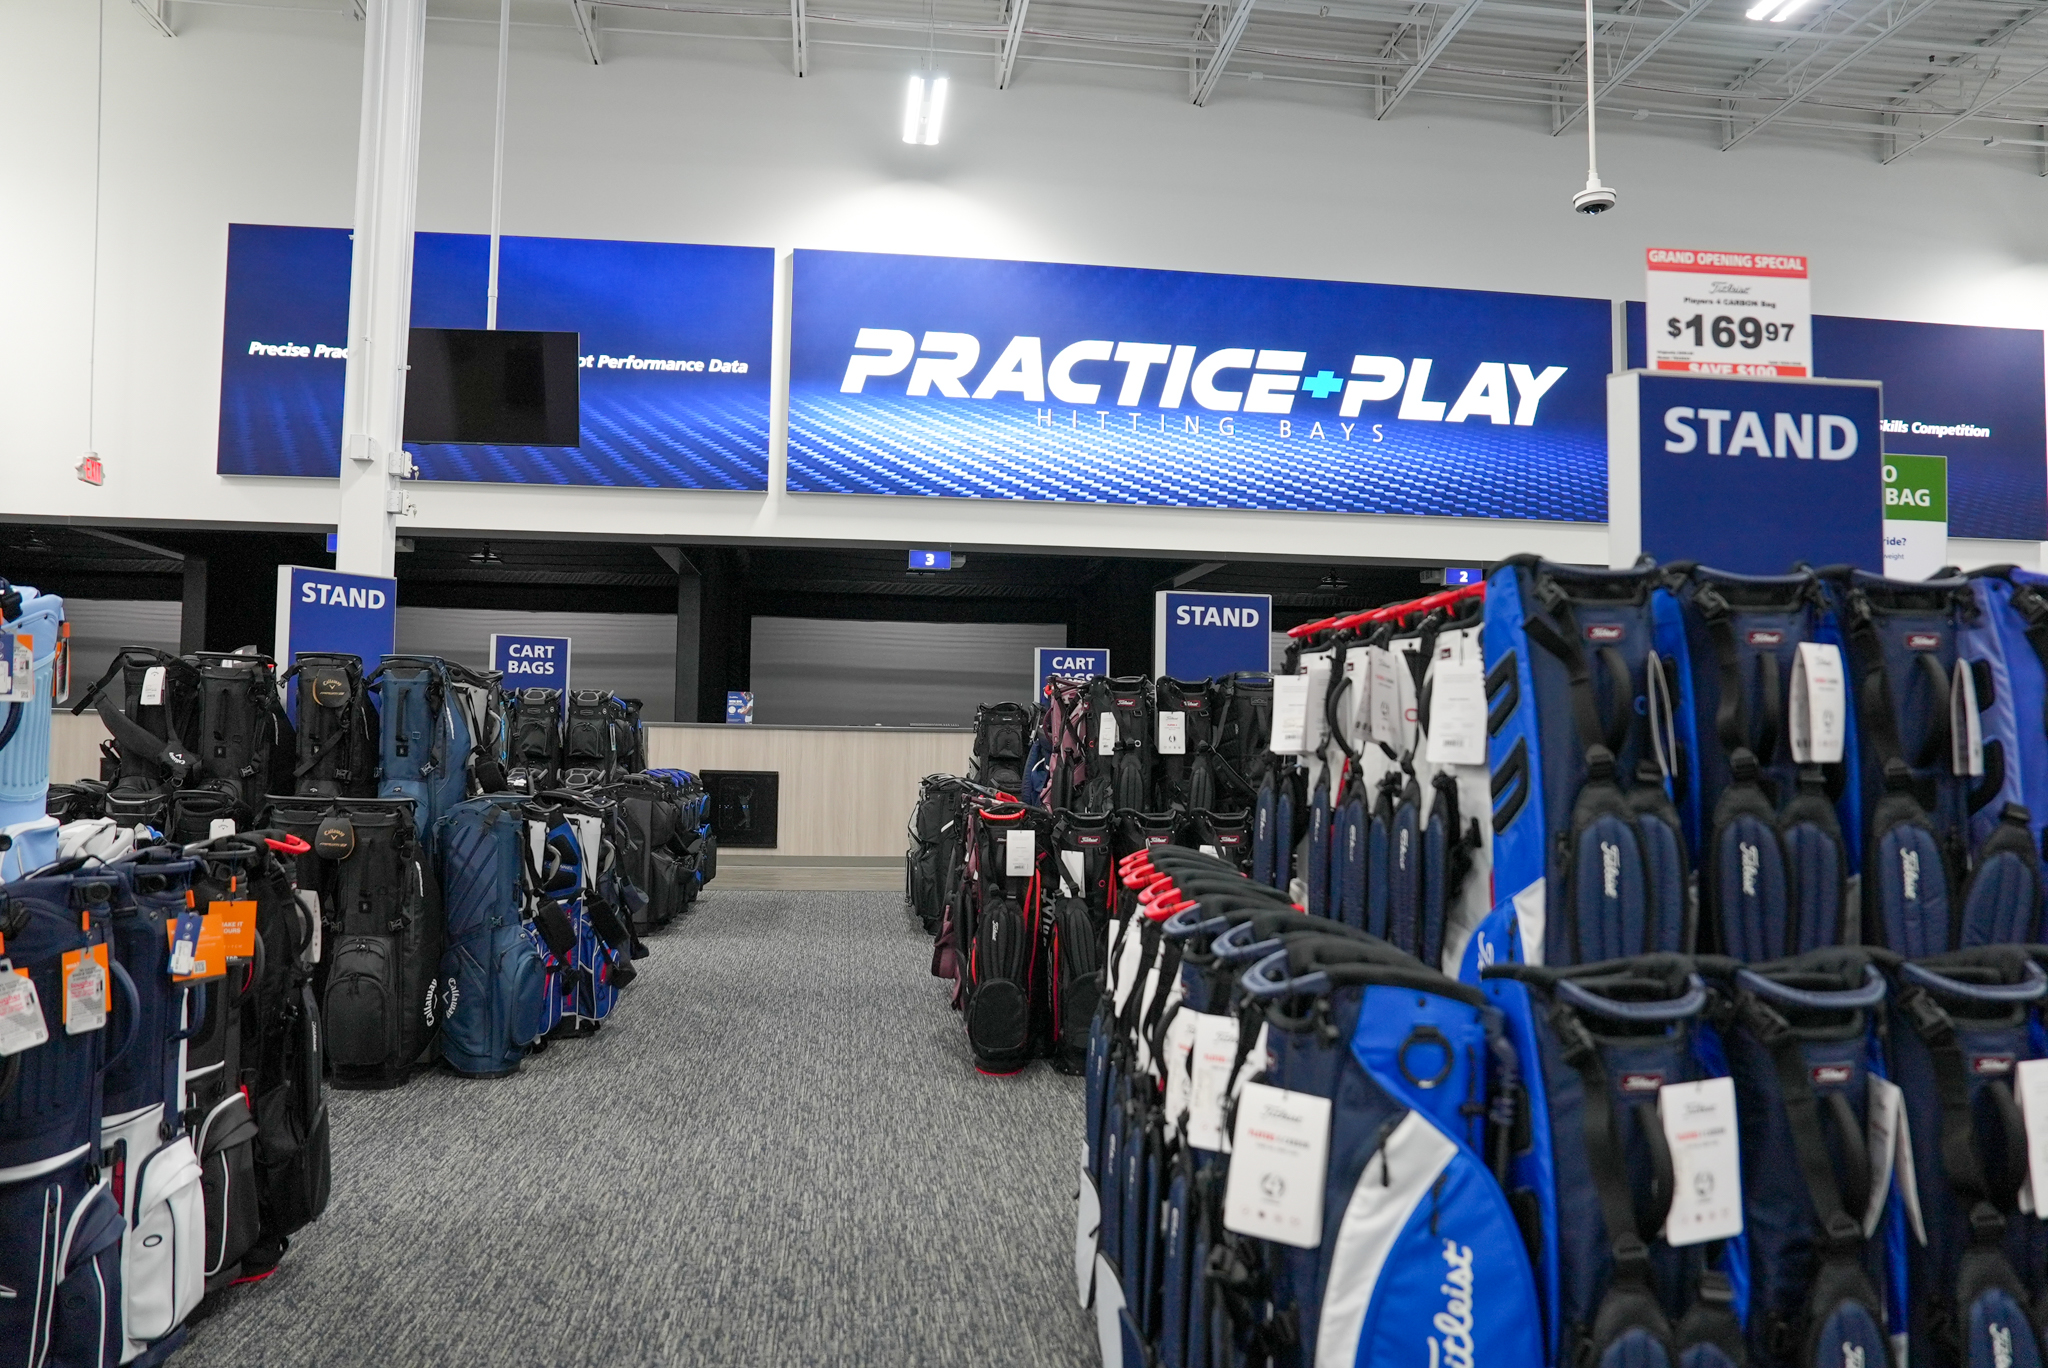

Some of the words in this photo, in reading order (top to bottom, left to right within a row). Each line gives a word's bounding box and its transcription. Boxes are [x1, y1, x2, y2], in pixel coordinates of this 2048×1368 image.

[1649, 250, 1695, 264] GRAND
[1697, 253, 1752, 267] OPENING
[1754, 256, 1804, 270] SPECIAL
[248, 341, 311, 358] Precise
[597, 355, 705, 372] Performance
[708, 358, 749, 374] Data
[1036, 407, 1235, 436] HITTING
[1279, 419, 1384, 443] BAYS
[1664, 406, 1859, 461] STAND
[1911, 421, 1990, 438] Competition
[1885, 488, 1930, 507] BAG
[925, 553, 935, 566] 3
[1459, 571, 1468, 582] 2
[301, 582, 386, 609] STAND
[1176, 605, 1260, 628] STAND
[508, 644, 555, 658] CART
[507, 661, 555, 675] BAGS
[1052, 656, 1095, 670] CART
[423, 978, 438, 1027] Callaway
[446, 977, 460, 1019] Callaway
